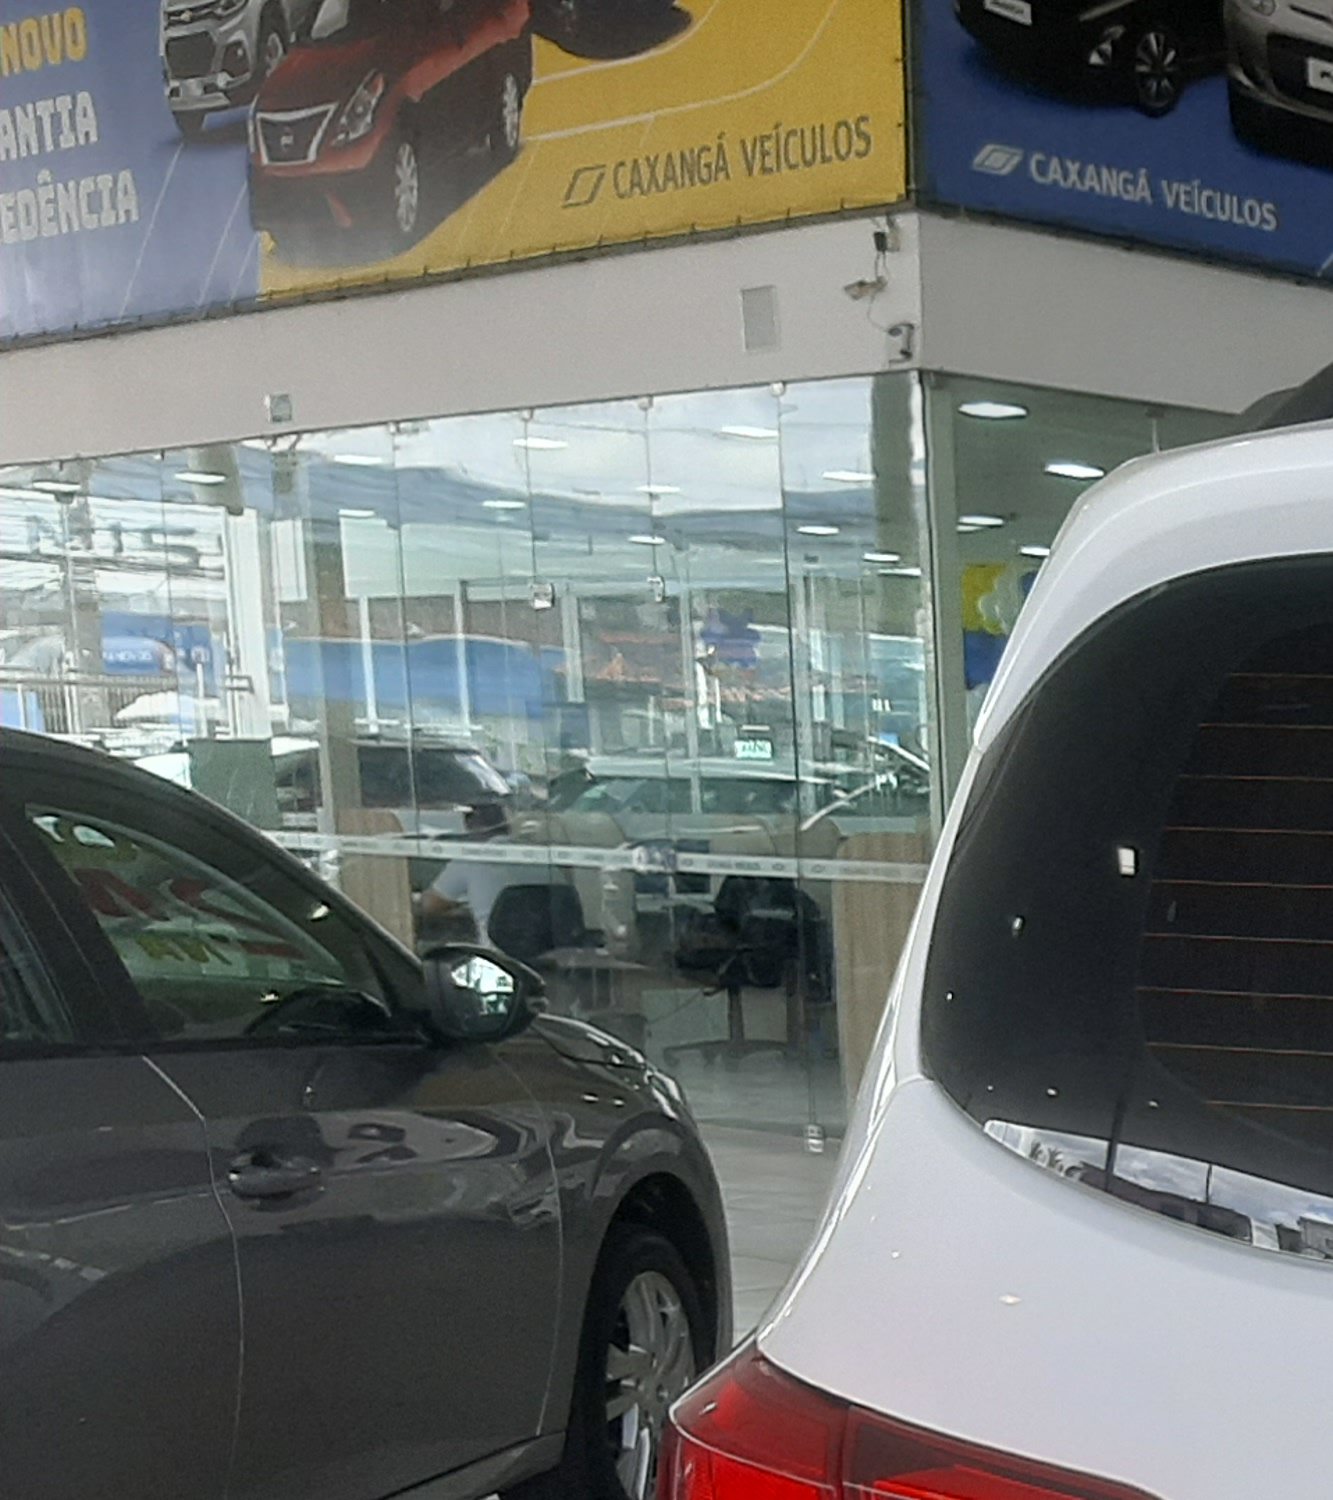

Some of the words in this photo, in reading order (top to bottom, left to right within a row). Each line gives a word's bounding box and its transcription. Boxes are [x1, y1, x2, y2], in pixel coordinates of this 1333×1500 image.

[0, 7, 87, 77] NOVO
[613, 132, 731, 200] CAXANGÁ
[740, 115, 873, 177] VEÍCULOS
[1029, 153, 1152, 204] CAXANGÁ
[1161, 179, 1279, 232] VEÍCULOS
